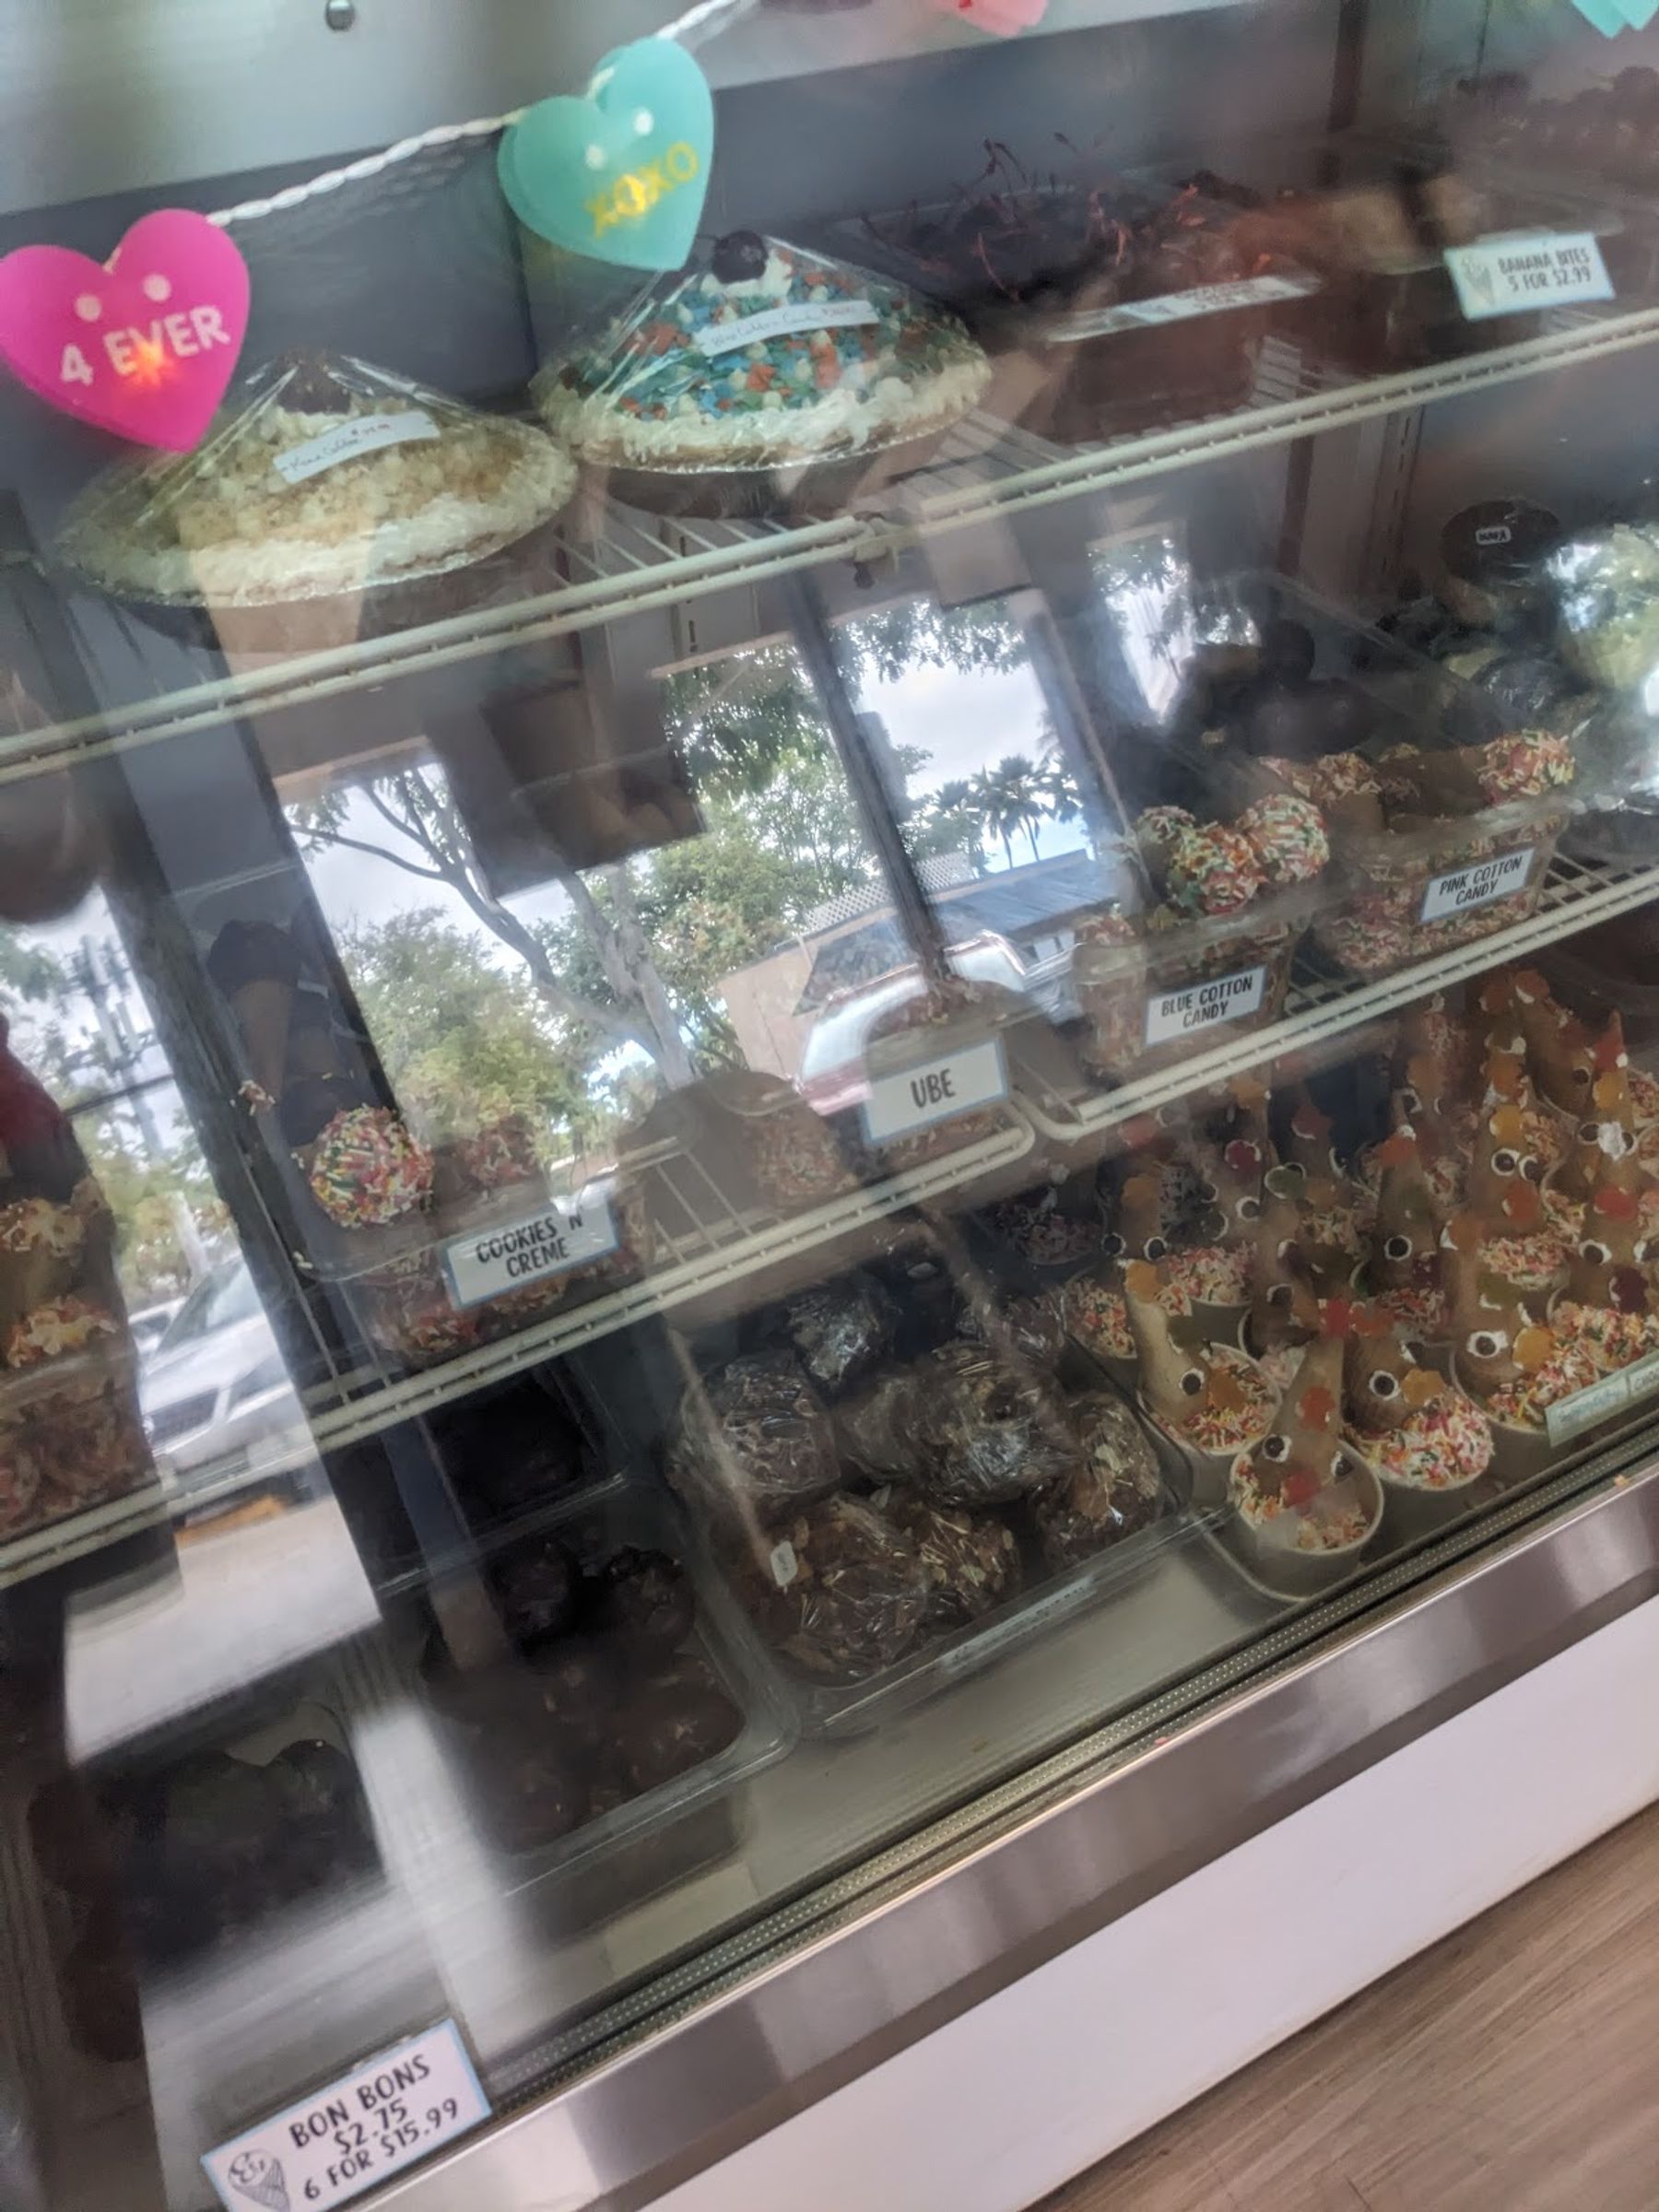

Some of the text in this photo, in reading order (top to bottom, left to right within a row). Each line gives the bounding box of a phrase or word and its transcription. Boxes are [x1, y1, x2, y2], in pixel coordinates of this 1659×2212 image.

[583, 142, 699, 239] XOXO
[1498, 247, 1591, 276] BANANA BITES
[1508, 265, 1592, 292] 5 FOR $2.99
[61, 305, 230, 386] 4 EVER
[1439, 855, 1524, 896] PINK COTTON
[1455, 878, 1499, 905] CANDY
[1161, 975, 1253, 1017] BLUE COTTON
[1182, 1001, 1230, 1029] CANDY
[910, 1067, 957, 1109] UBE
[476, 1217, 558, 1264] COOKIES
[506, 1237, 571, 1277] CREME
[288, 2053, 430, 2149] BON BONS
[334, 2098, 408, 2156] $2.75
[304, 2098, 458, 2200] 6 FOR $15.99
